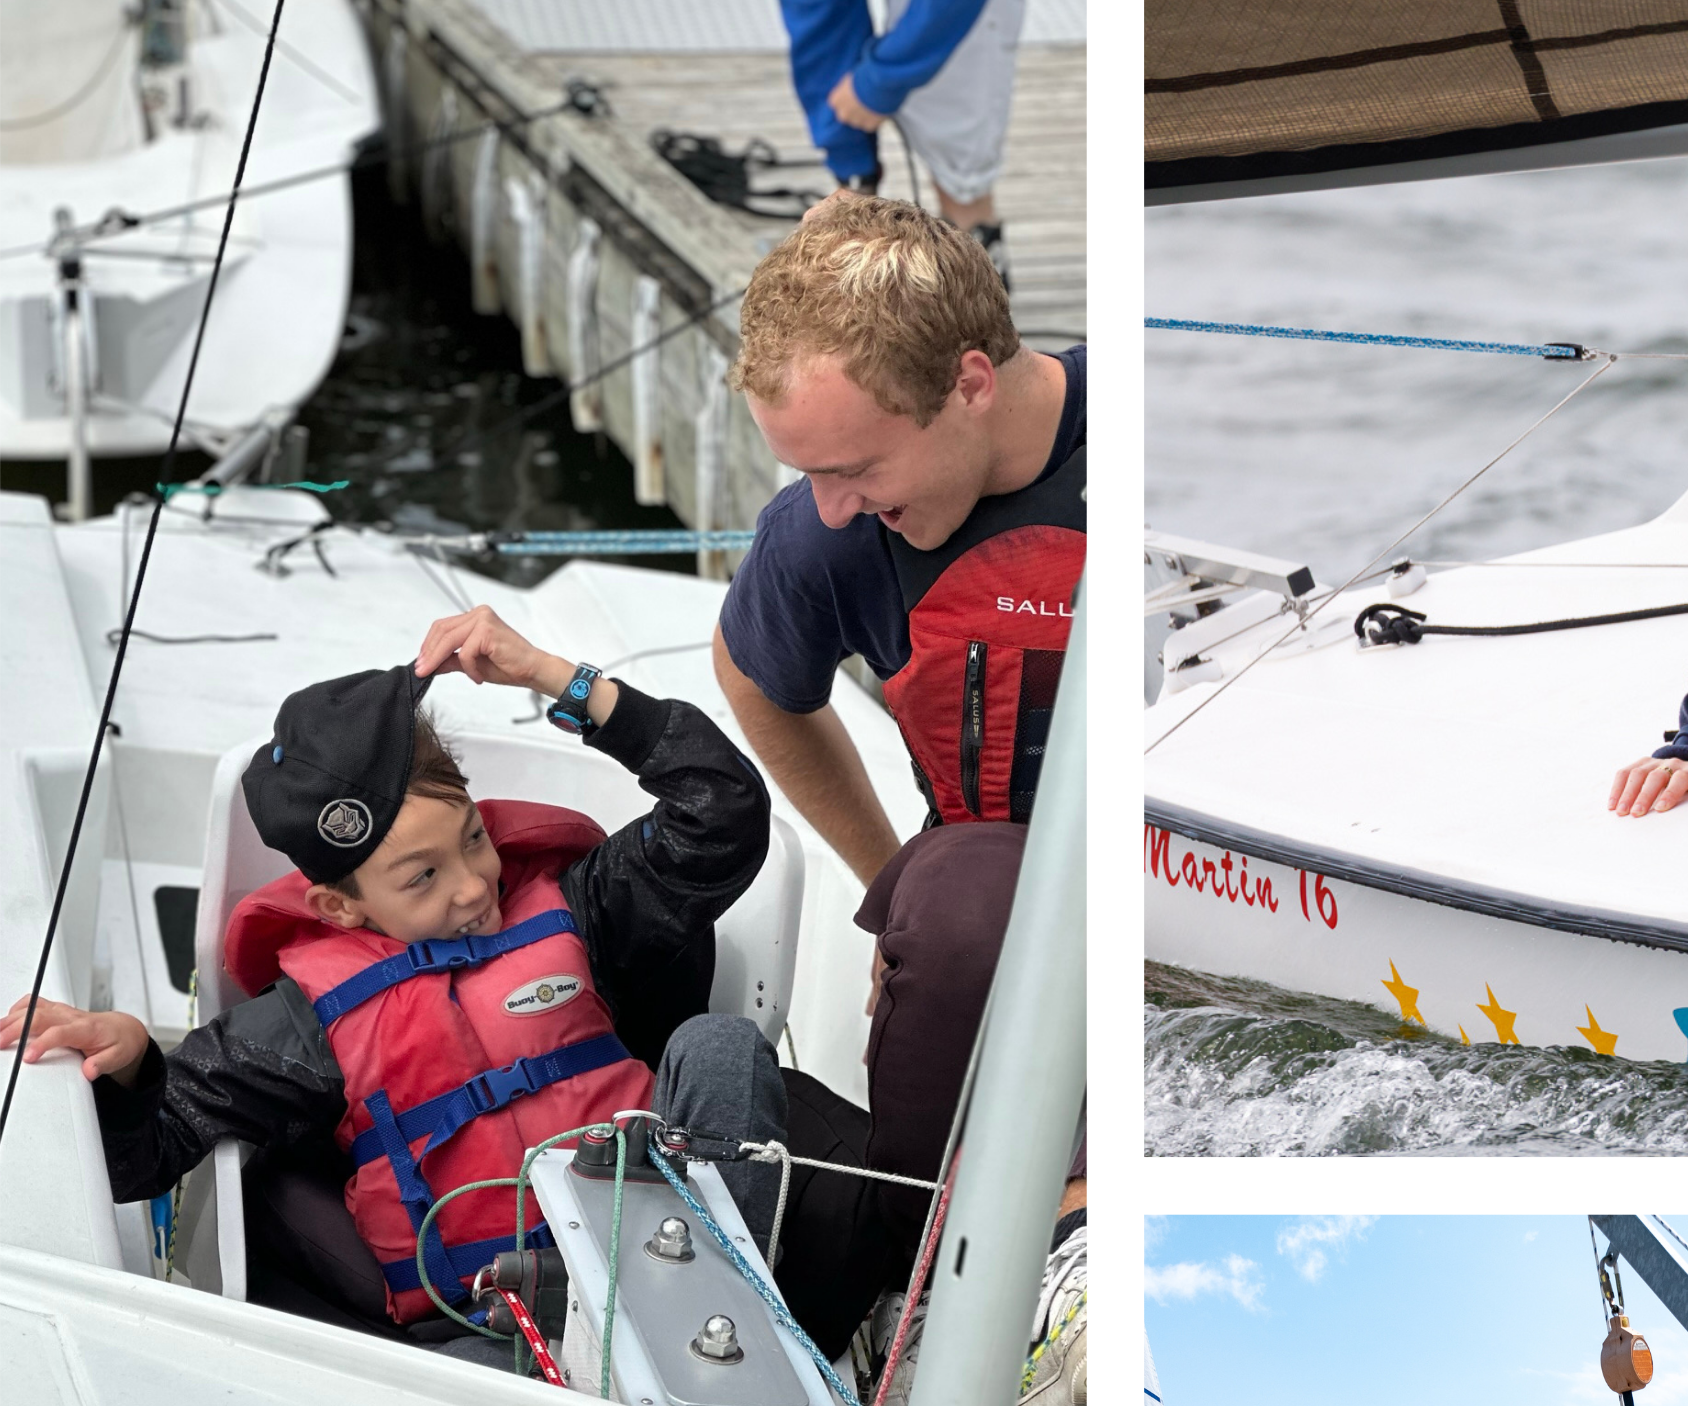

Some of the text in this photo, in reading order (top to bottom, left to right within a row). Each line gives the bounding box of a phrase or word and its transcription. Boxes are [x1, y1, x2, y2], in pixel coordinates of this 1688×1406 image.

[972, 689, 980, 724] SALUS
[1144, 824, 1338, 930] Martin 16
